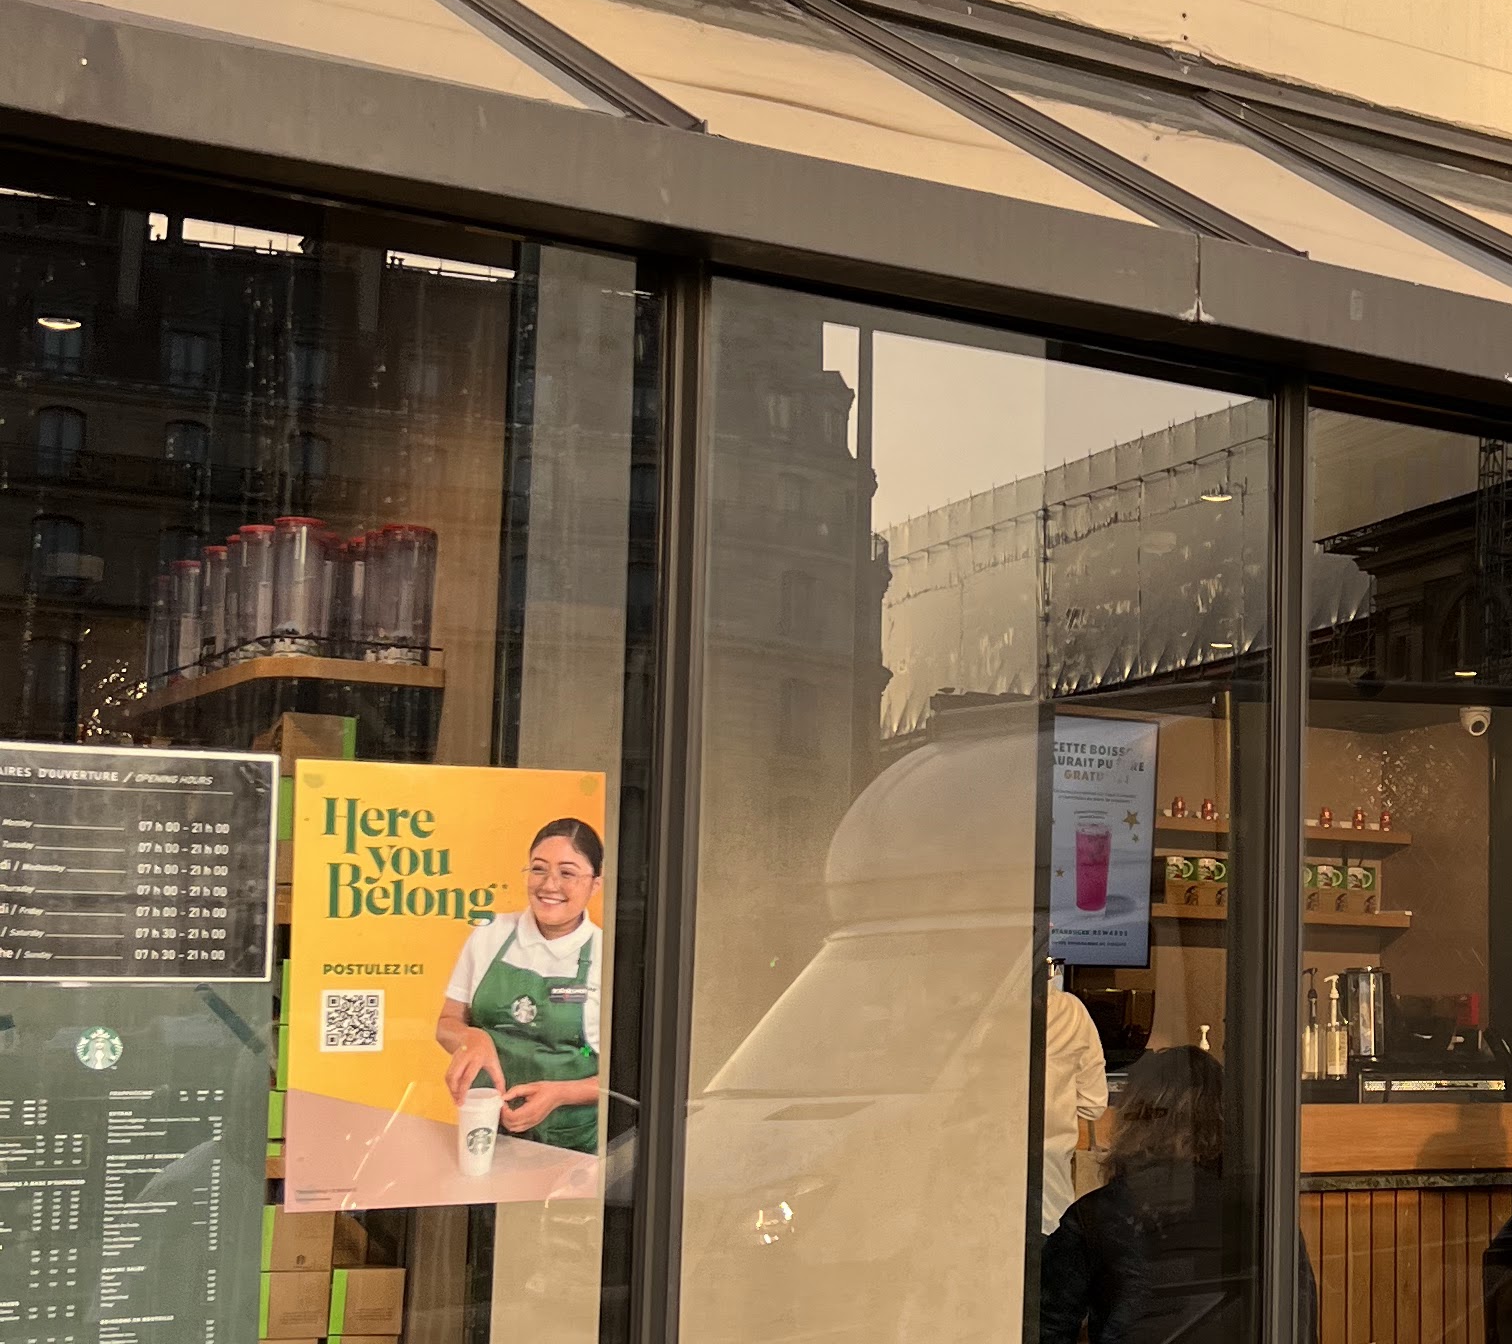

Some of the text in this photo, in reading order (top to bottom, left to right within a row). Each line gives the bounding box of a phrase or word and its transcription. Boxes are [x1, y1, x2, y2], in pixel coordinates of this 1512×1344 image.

[1089, 744, 1134, 758] BOISS
[1097, 758, 1114, 770] PU
[38, 768, 119, 782] D'OUVERTURE
[135, 773, 178, 784] OPENING
[179, 775, 214, 786] HOURS
[138, 821, 153, 831] 07
[321, 796, 436, 855] Here
[138, 842, 152, 853] 07
[137, 863, 151, 874] 07
[366, 845, 453, 886] you
[136, 885, 151, 895] 07
[326, 862, 497, 927] Belong
[135, 906, 150, 916] 07
[135, 928, 149, 938] 07
[134, 949, 149, 960] 07
[322, 963, 424, 976] POSTULEZ ICI
